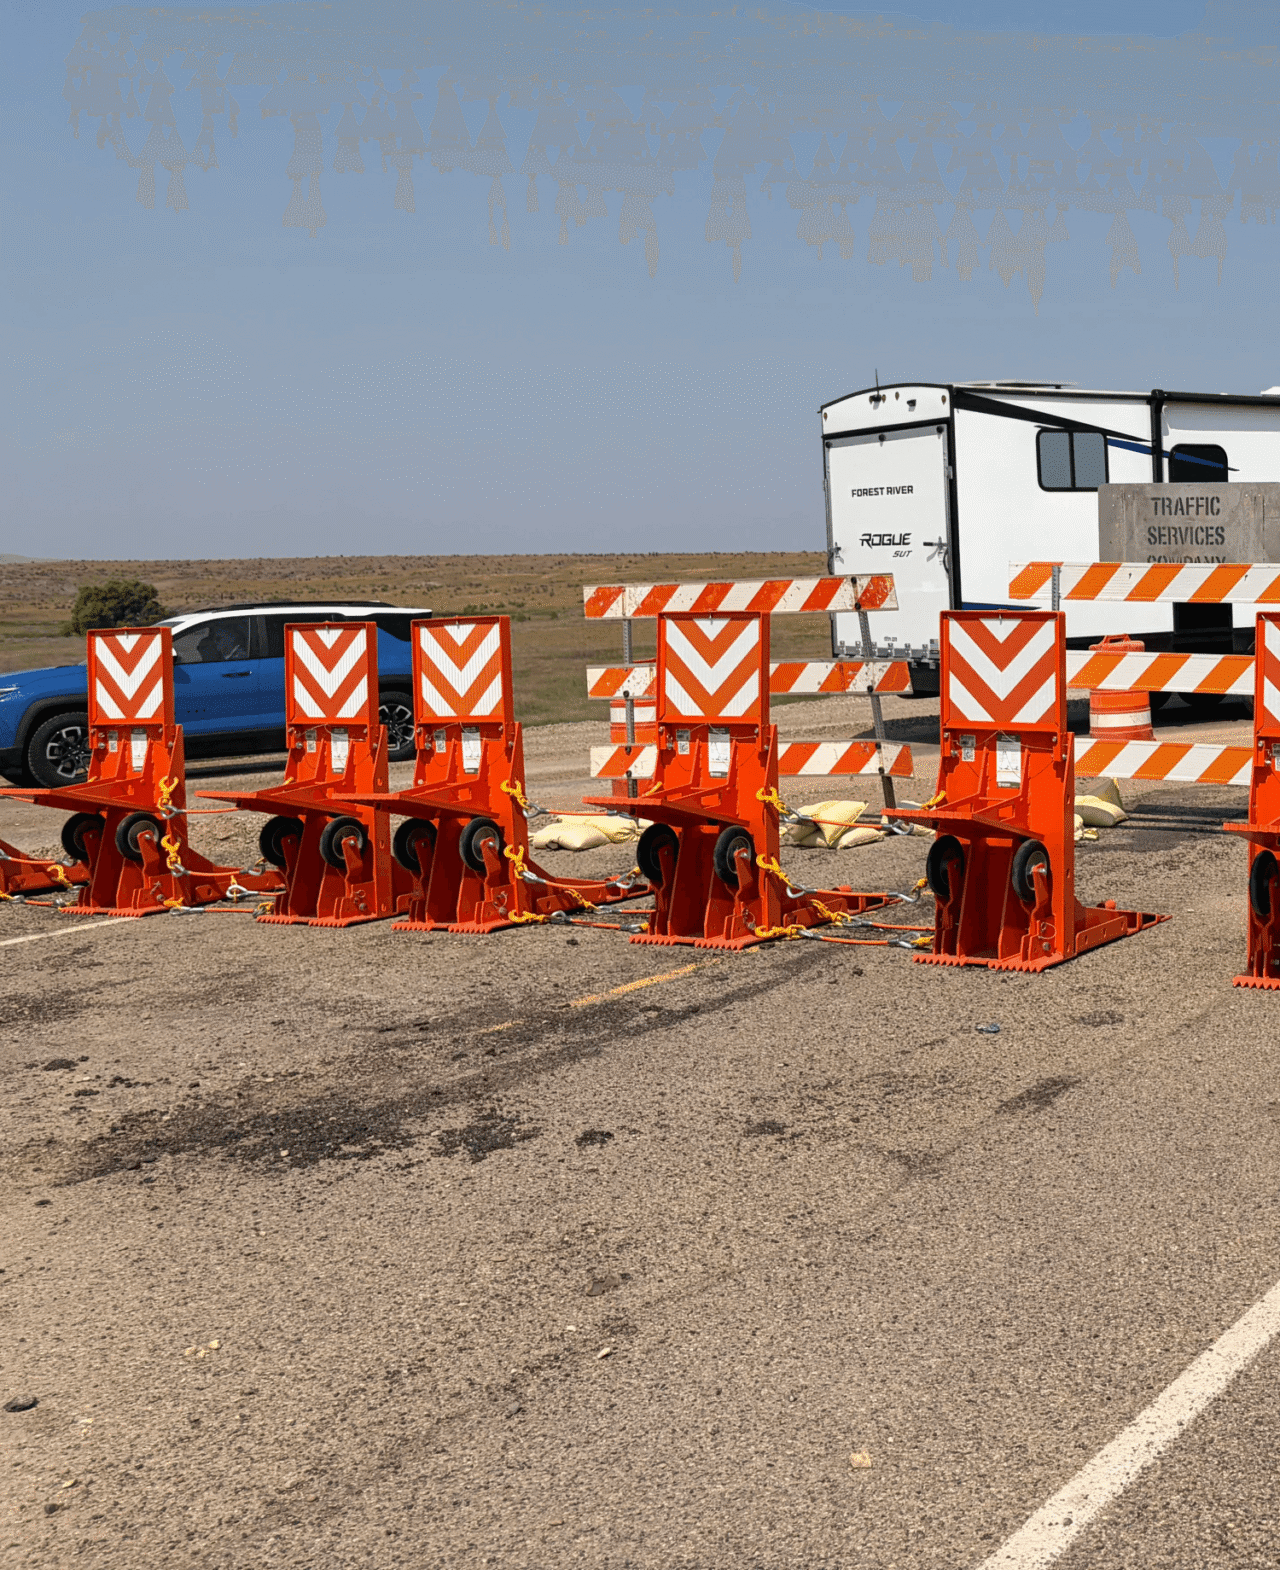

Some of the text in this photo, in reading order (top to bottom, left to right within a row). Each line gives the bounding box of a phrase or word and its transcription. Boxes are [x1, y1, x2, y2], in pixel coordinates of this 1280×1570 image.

[851, 485, 914, 498] FOREST RIVER
[1150, 496, 1221, 516] TRAFFIC
[859, 532, 912, 549] ROGUE
[1147, 526, 1226, 546] SERVICES
[892, 550, 913, 558] SUT
